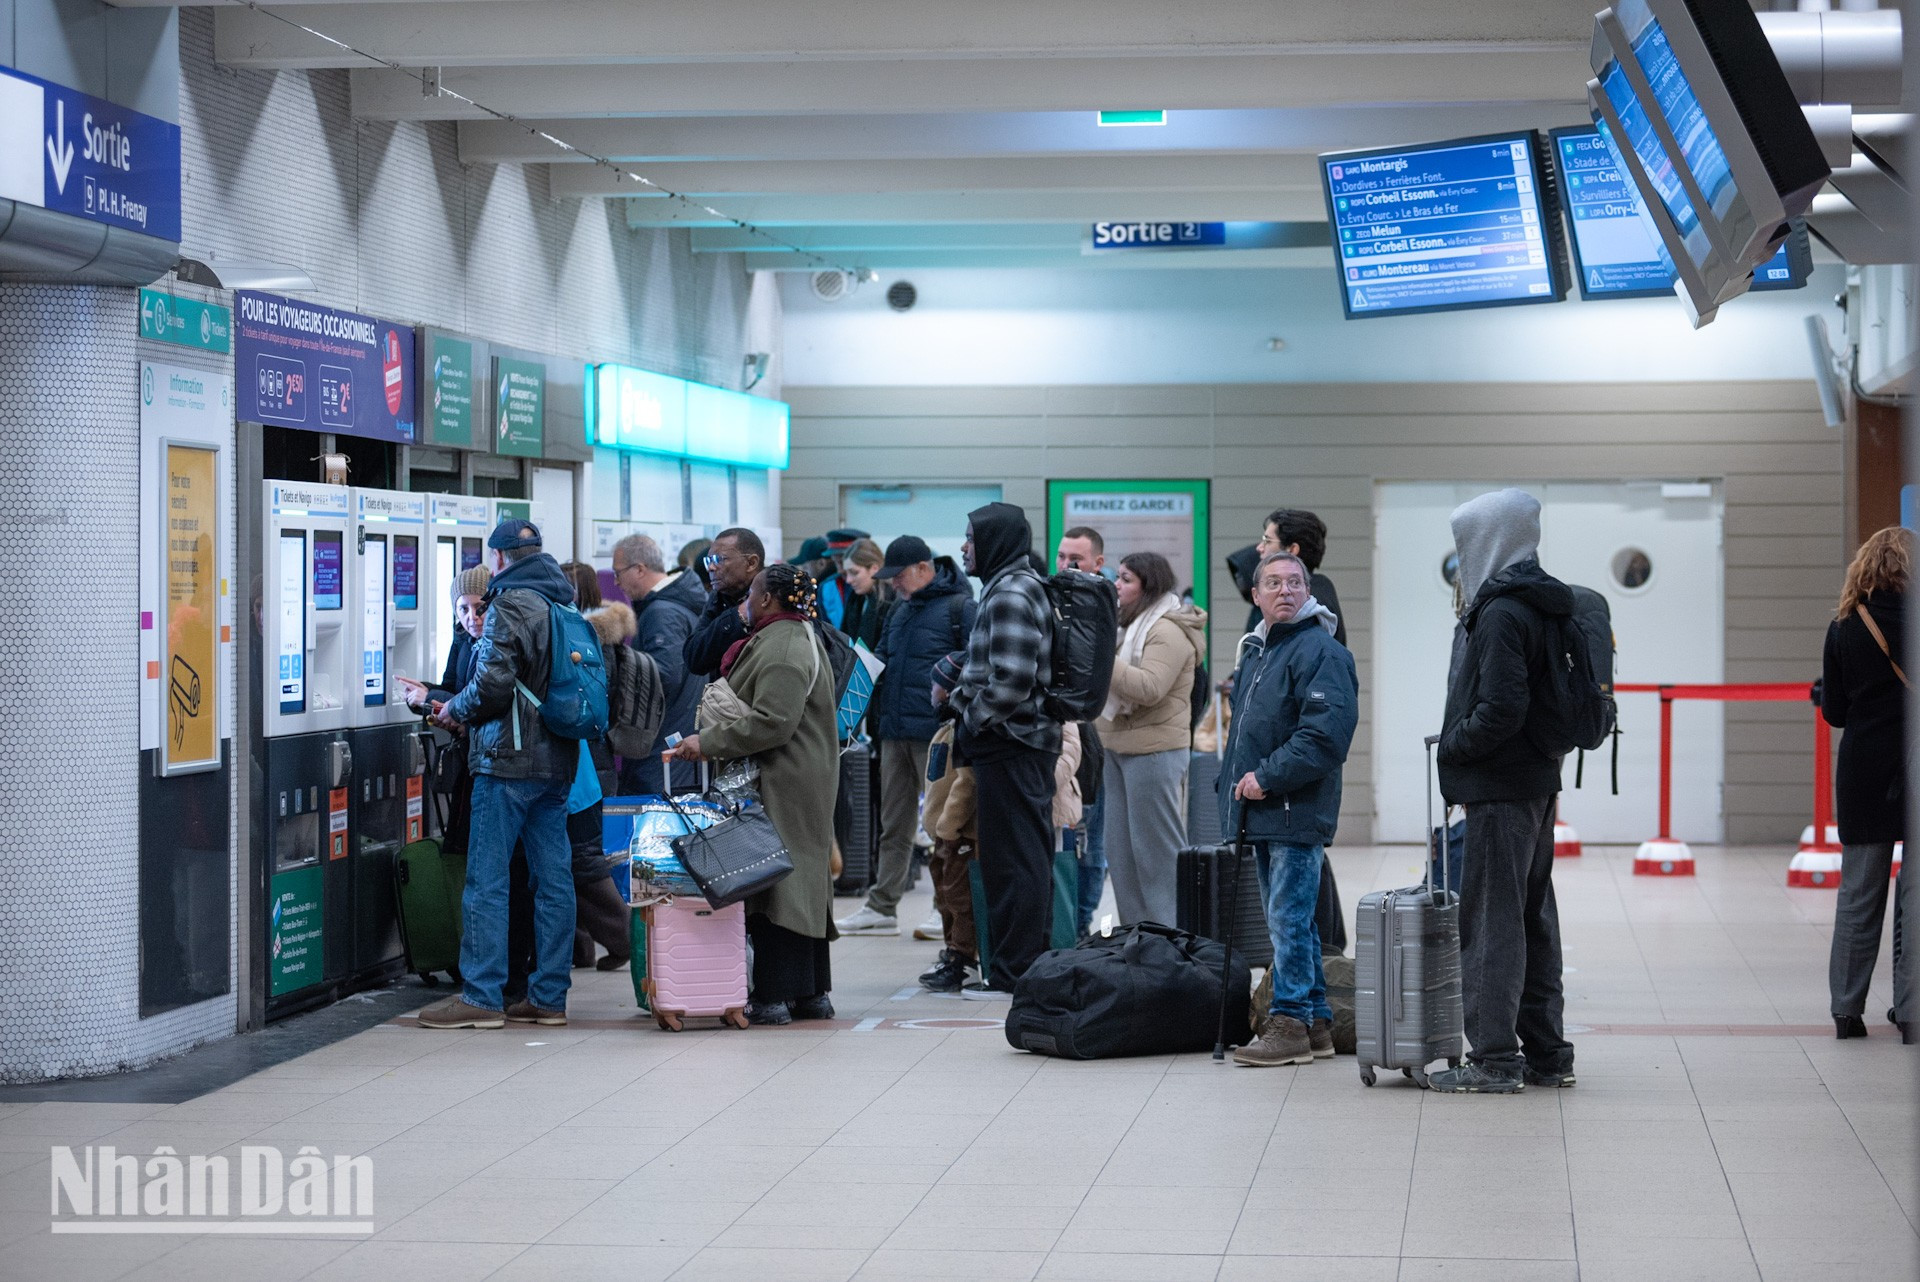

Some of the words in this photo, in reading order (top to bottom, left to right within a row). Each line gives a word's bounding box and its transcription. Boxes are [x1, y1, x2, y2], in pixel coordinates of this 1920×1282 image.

[83, 112, 130, 171] Sortie
[1361, 158, 1408, 173] Montargis
[1574, 157, 1598, 168] Stade
[1600, 156, 1610, 166] de
[1342, 180, 1378, 191] Dordives
[1385, 176, 1421, 186] Ferrières
[1423, 172, 1445, 182] Font.
[1366, 191, 1401, 205] Corbeil
[1401, 189, 1439, 201] Essonn.
[1580, 189, 1620, 201] Survilliers
[87, 184, 94, 207] 9
[99, 188, 110, 213] Pl.
[111, 195, 120, 216] H.
[121, 196, 147, 228] Frenay
[1347, 212, 1365, 224] Évry
[1367, 211, 1393, 221] Courc.
[1401, 209, 1411, 218] Le
[1413, 206, 1431, 216] Bras
[1433, 205, 1444, 214] de
[1445, 203, 1459, 213] Fer
[1095, 222, 1173, 244] Sortie
[1184, 222, 1195, 237] 2
[1371, 225, 1401, 237] Melun
[1374, 239, 1410, 253] Corbeil
[1410, 238, 1447, 249] Essonn.
[1377, 263, 1429, 277] Montereau
[167, 311, 185, 329] Services
[211, 321, 227, 338] Tickets
[241, 297, 264, 322] POUR
[265, 301, 278, 325] LES
[279, 304, 322, 335] VOYAGEURS
[323, 314, 378, 348] OCCASIONNELS,
[169, 373, 204, 395] Information
[281, 489, 294, 503] Tickets
[299, 490, 311, 507] Navigo
[365, 496, 376, 509] Tickets
[381, 498, 392, 514] Navigo
[1074, 499, 1124, 510] PRENEZ
[1129, 499, 1175, 510] GARDE
